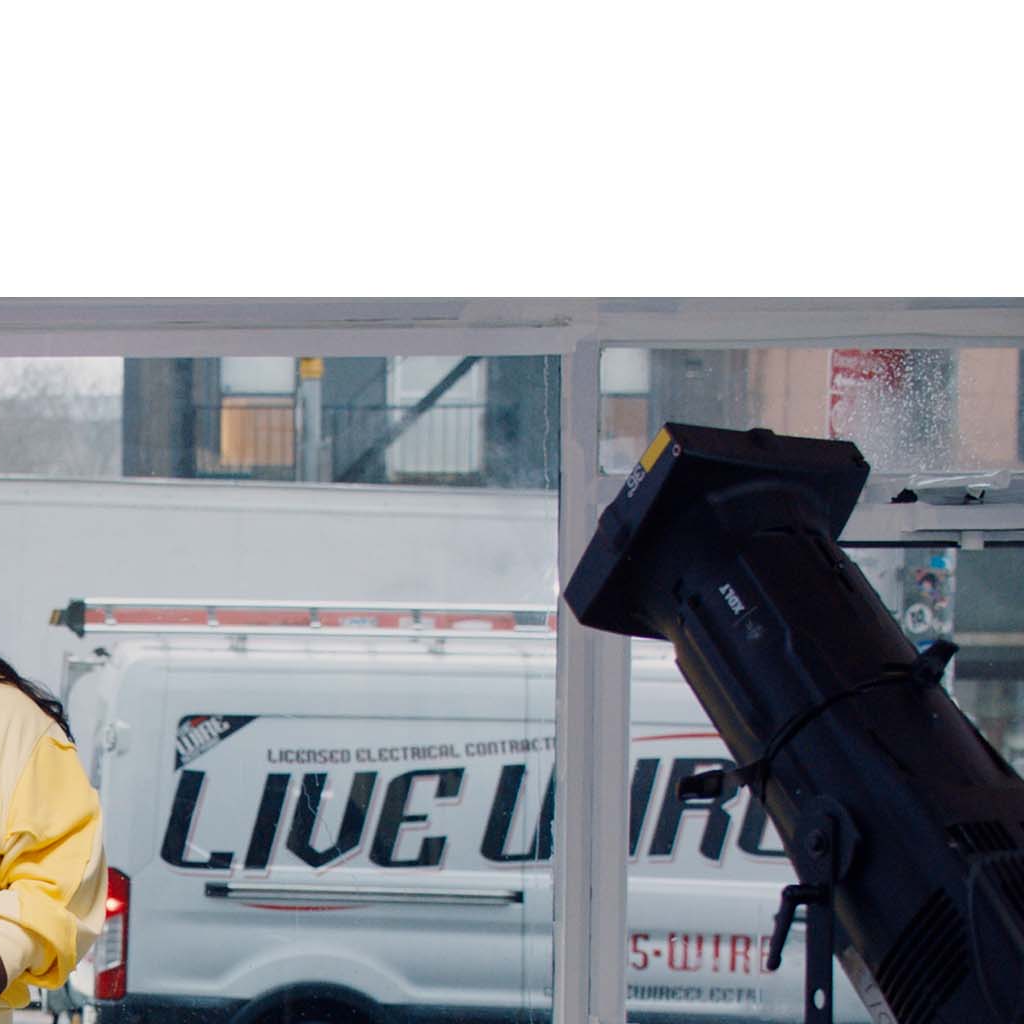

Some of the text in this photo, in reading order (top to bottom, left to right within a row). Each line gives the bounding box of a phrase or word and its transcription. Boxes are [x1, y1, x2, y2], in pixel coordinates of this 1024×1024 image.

[267, 737, 557, 764] LICENSED ELECTRICAL CONTRACT
[161, 768, 466, 869] LIVE
